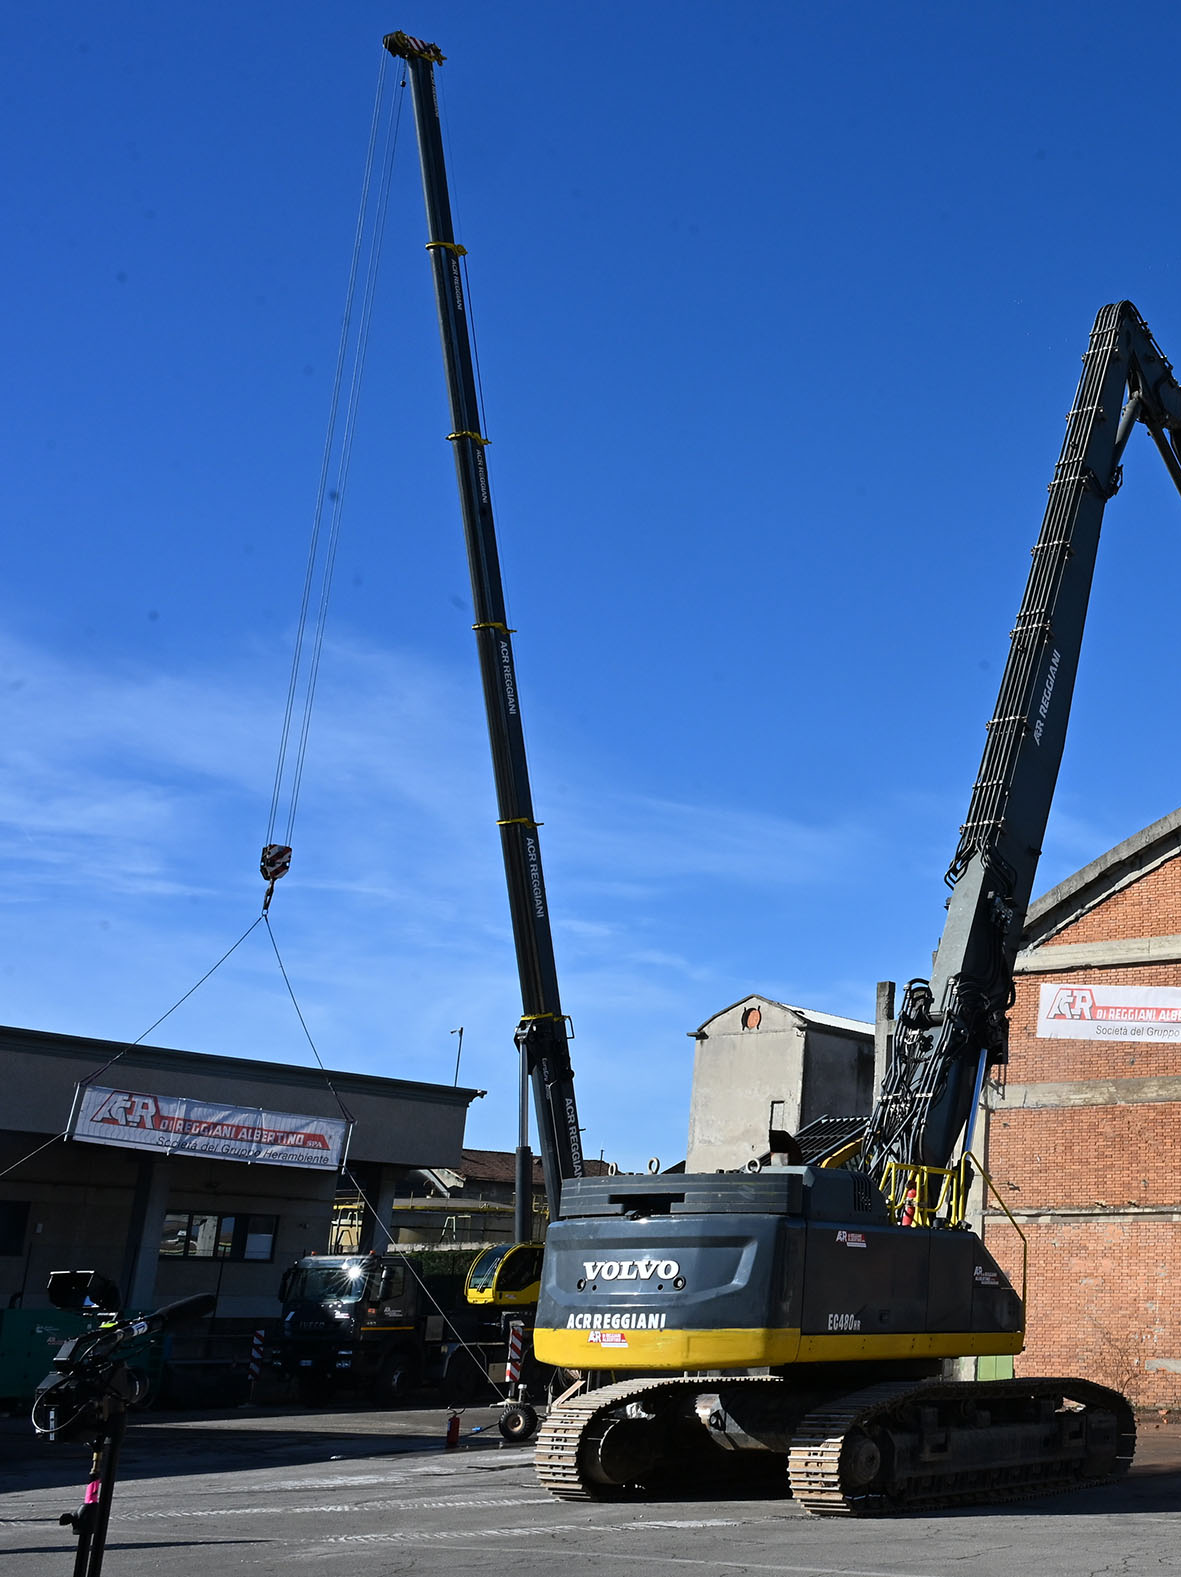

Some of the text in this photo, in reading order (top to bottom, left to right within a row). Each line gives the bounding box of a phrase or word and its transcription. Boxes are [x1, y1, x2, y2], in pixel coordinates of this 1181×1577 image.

[478, 466, 488, 504] REGGIANI
[500, 640, 517, 715] ACR REGGIANI
[1039, 649, 1061, 719] REGGIANI
[526, 837, 544, 918] ACR REGGIANI
[1096, 1009, 1106, 1019] DI
[1108, 1009, 1157, 1020] REGGIANI
[1096, 1025, 1128, 1036] Società
[1130, 1026, 1144, 1036] del
[1146, 1027, 1180, 1039] Gruppo
[160, 1120, 173, 1131] DI
[175, 1121, 237, 1140] REGGIANI
[238, 1128, 305, 1147] ALBERTINO
[565, 1097, 584, 1180] ACR REGGIAN
[156, 1136, 330, 1165] Società del Gruppo Herambiente
[583, 1260, 680, 1281] VOLVO
